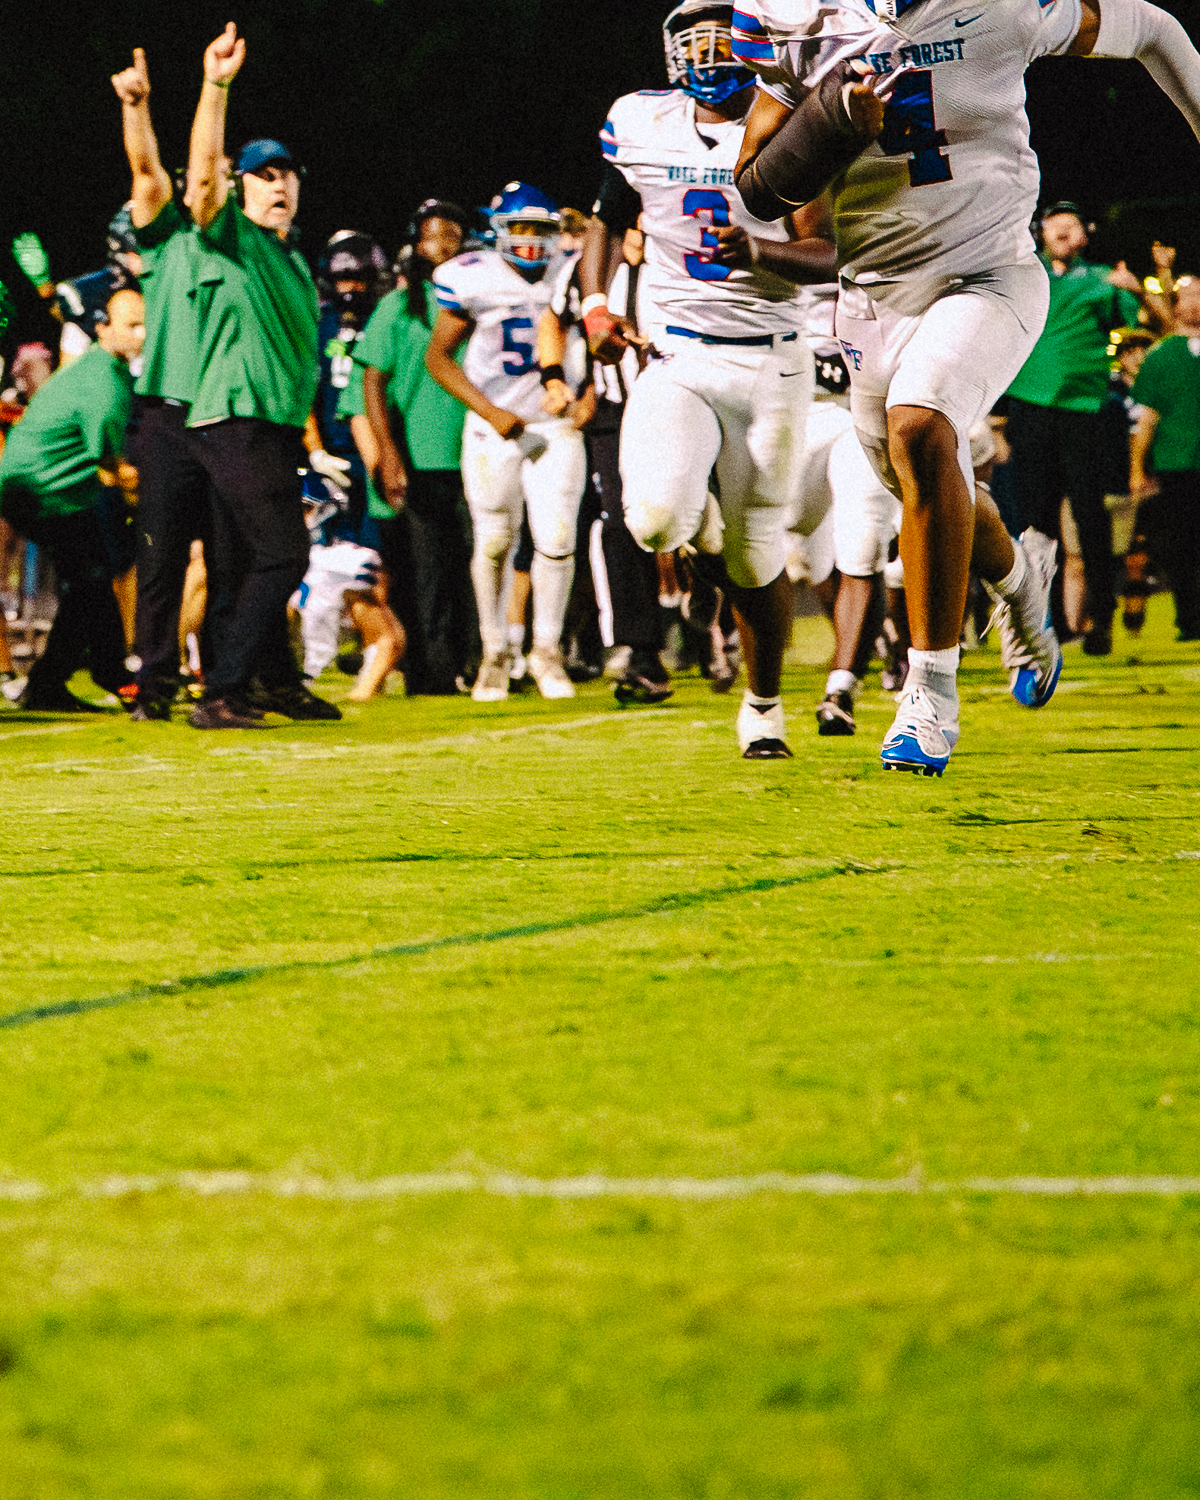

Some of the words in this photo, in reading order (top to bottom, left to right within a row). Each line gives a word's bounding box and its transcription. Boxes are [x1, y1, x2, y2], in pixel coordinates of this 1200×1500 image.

[899, 38, 965, 68] FOREST
[703, 167, 735, 186] FORE
[682, 188, 731, 281] 3
[501, 317, 533, 377] 5
